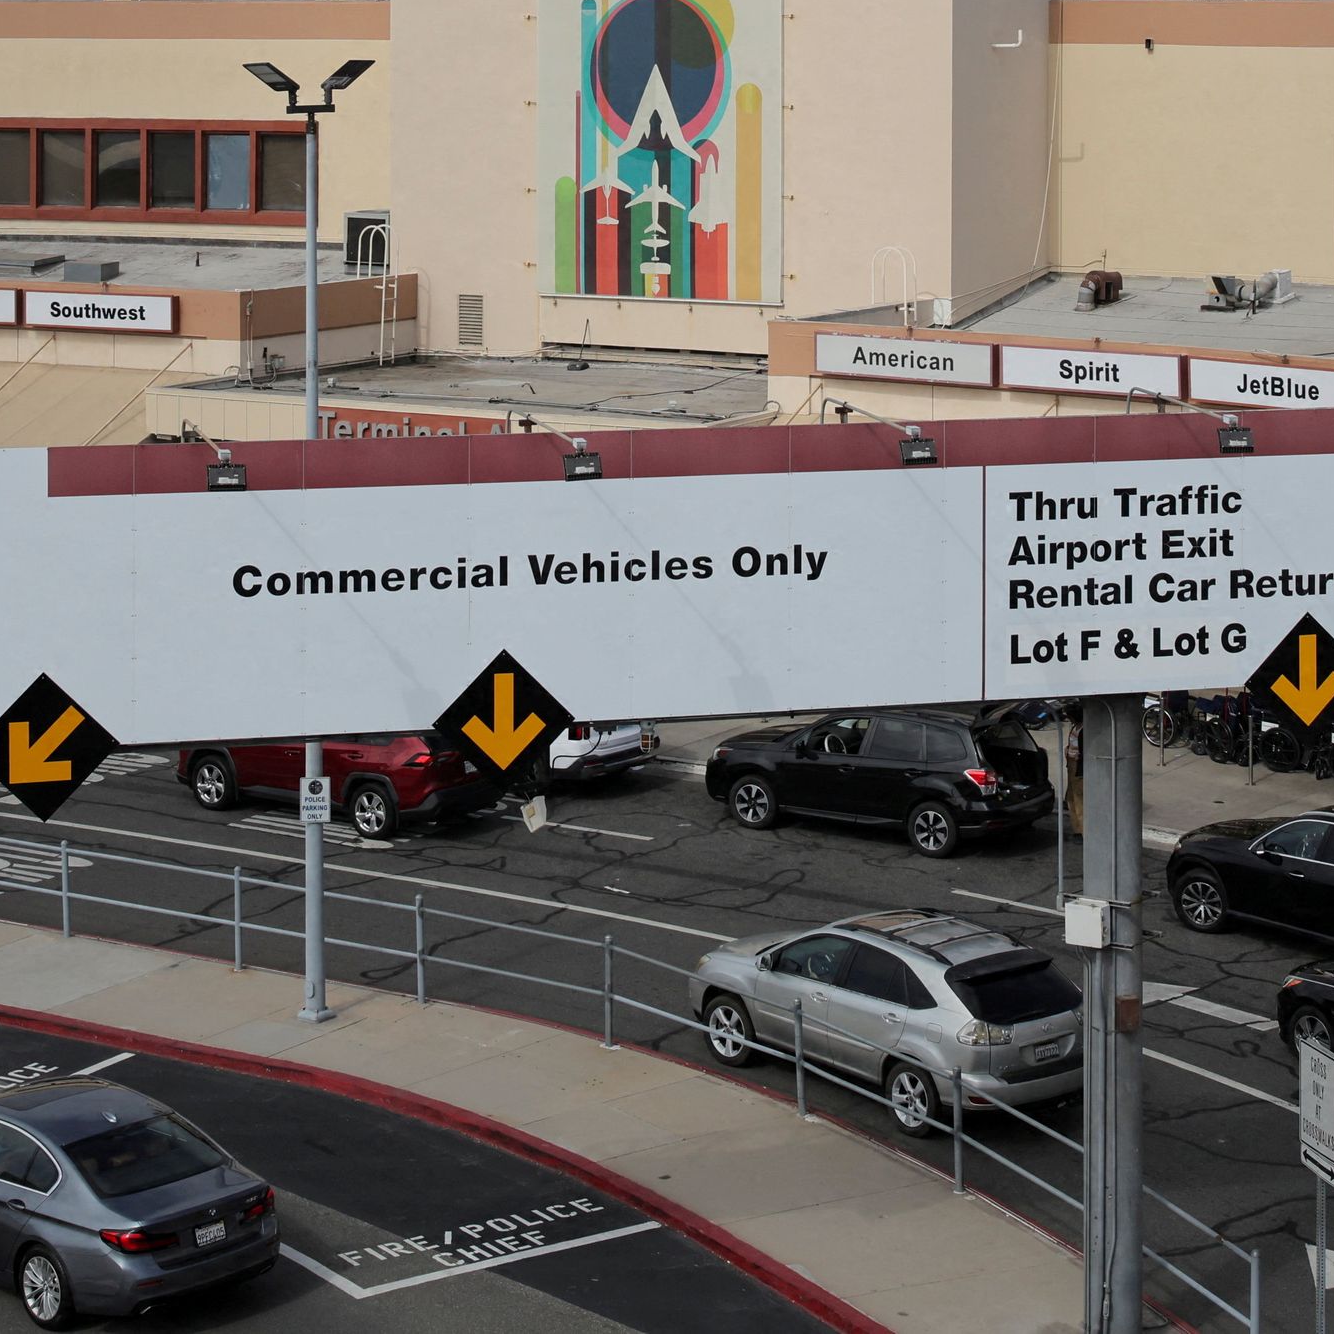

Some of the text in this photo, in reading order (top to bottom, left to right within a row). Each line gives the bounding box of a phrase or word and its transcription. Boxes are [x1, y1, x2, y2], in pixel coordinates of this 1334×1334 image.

[50, 301, 146, 321] Southwest
[852, 345, 955, 372] American
[1059, 359, 1120, 385] Spirit
[1236, 373, 1320, 401] JetBlue
[1008, 485, 1243, 522] Thru Traffic
[1008, 528, 1234, 570] Airport Exit
[232, 544, 828, 598] Commercial Vehicles Only
[1009, 574, 1133, 609] Rental
[1148, 572, 1216, 603] Car
[1010, 622, 1247, 664] Lot F & Lot G
[432, 1230, 549, 1267] CHIEF
